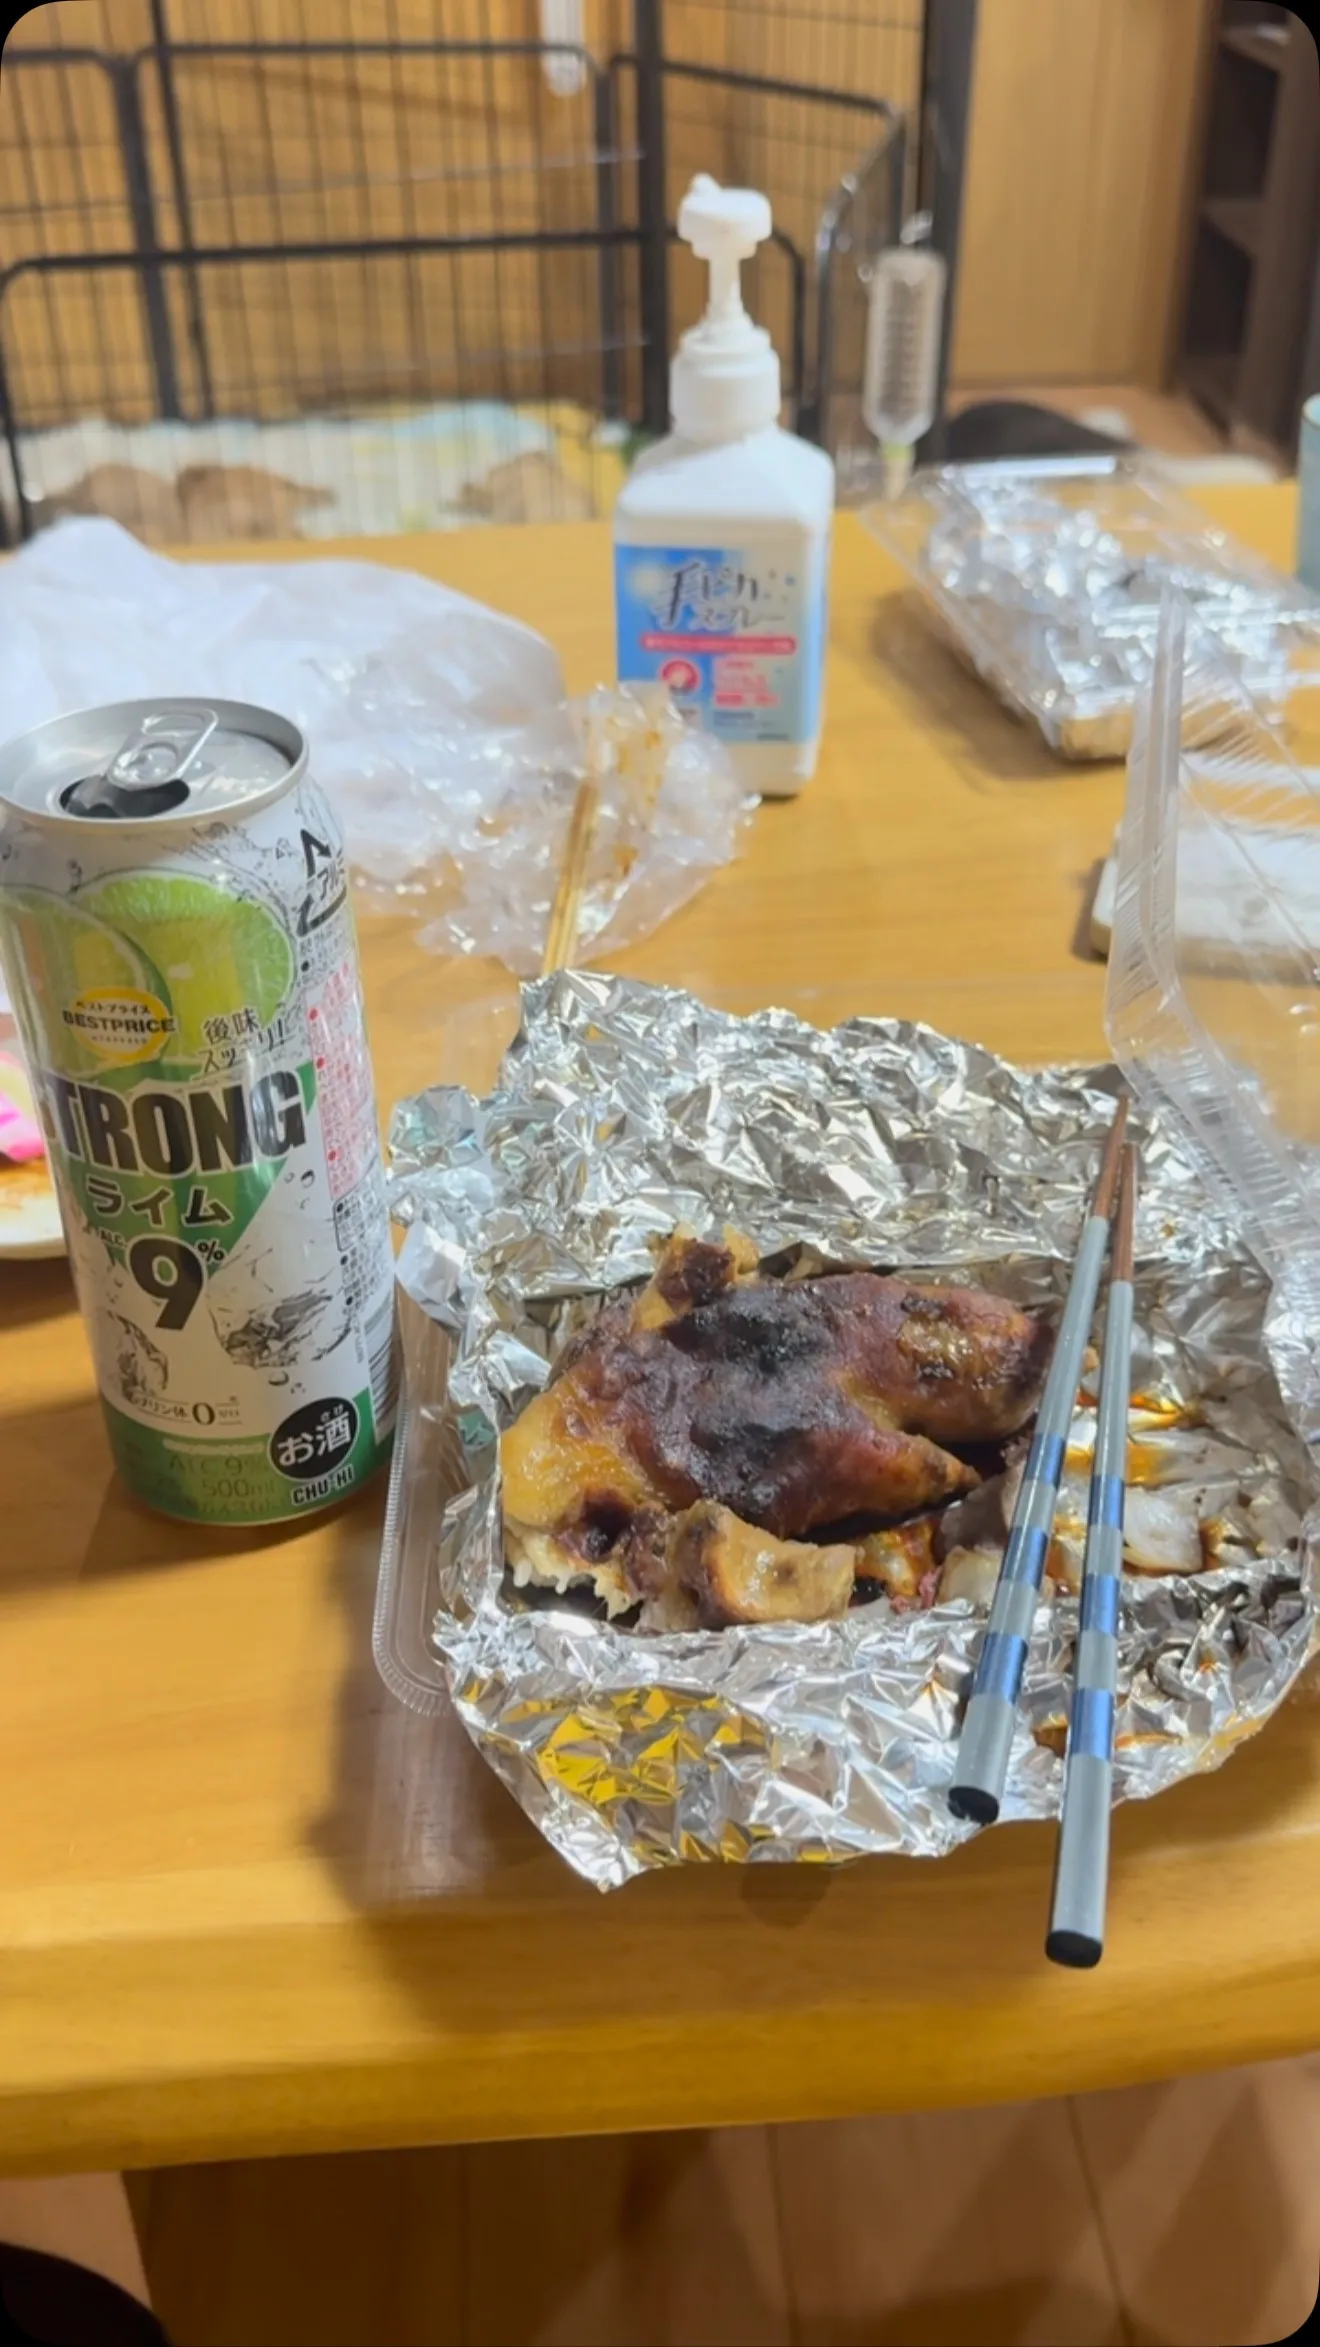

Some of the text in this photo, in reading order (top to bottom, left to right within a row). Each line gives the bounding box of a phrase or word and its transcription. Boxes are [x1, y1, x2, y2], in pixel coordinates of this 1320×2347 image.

[62, 1010, 176, 1033] BESTPRICE
[203, 1007, 259, 1044] 後味
[47, 1070, 306, 1176] TRONG
[87, 1176, 232, 1226] ライム
[276, 1410, 352, 1467] お酒
